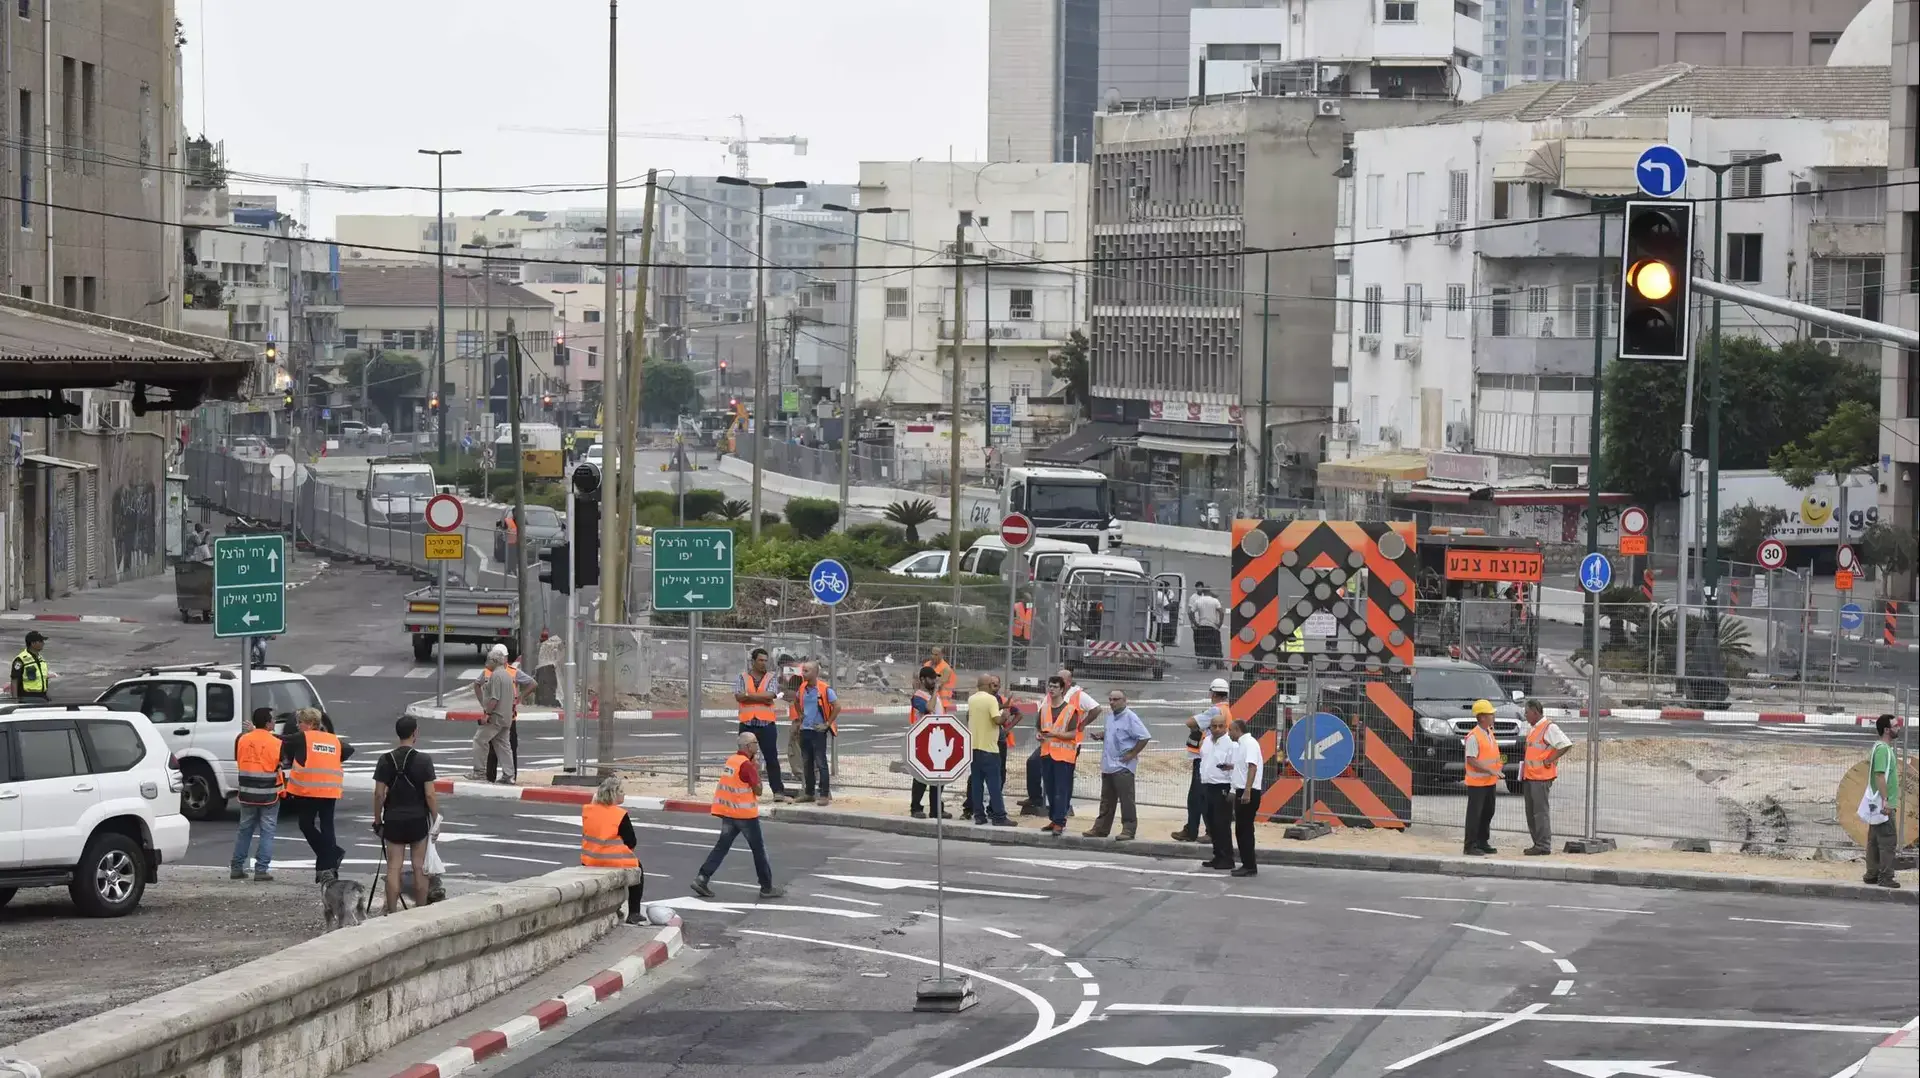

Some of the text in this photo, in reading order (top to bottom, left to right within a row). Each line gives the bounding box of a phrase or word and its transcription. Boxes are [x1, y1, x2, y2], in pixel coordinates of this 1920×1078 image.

[660, 537, 687, 547] הרצל
[220, 547, 245, 559] הרצל
[679, 552, 693, 561] יפו
[1764, 549, 1779, 560] 30
[237, 564, 250, 574] יפו
[1450, 558, 1538, 576] קבוצת צבע
[661, 574, 724, 587] נתיבי איילון
[222, 592, 277, 608] נתיבי איילון
